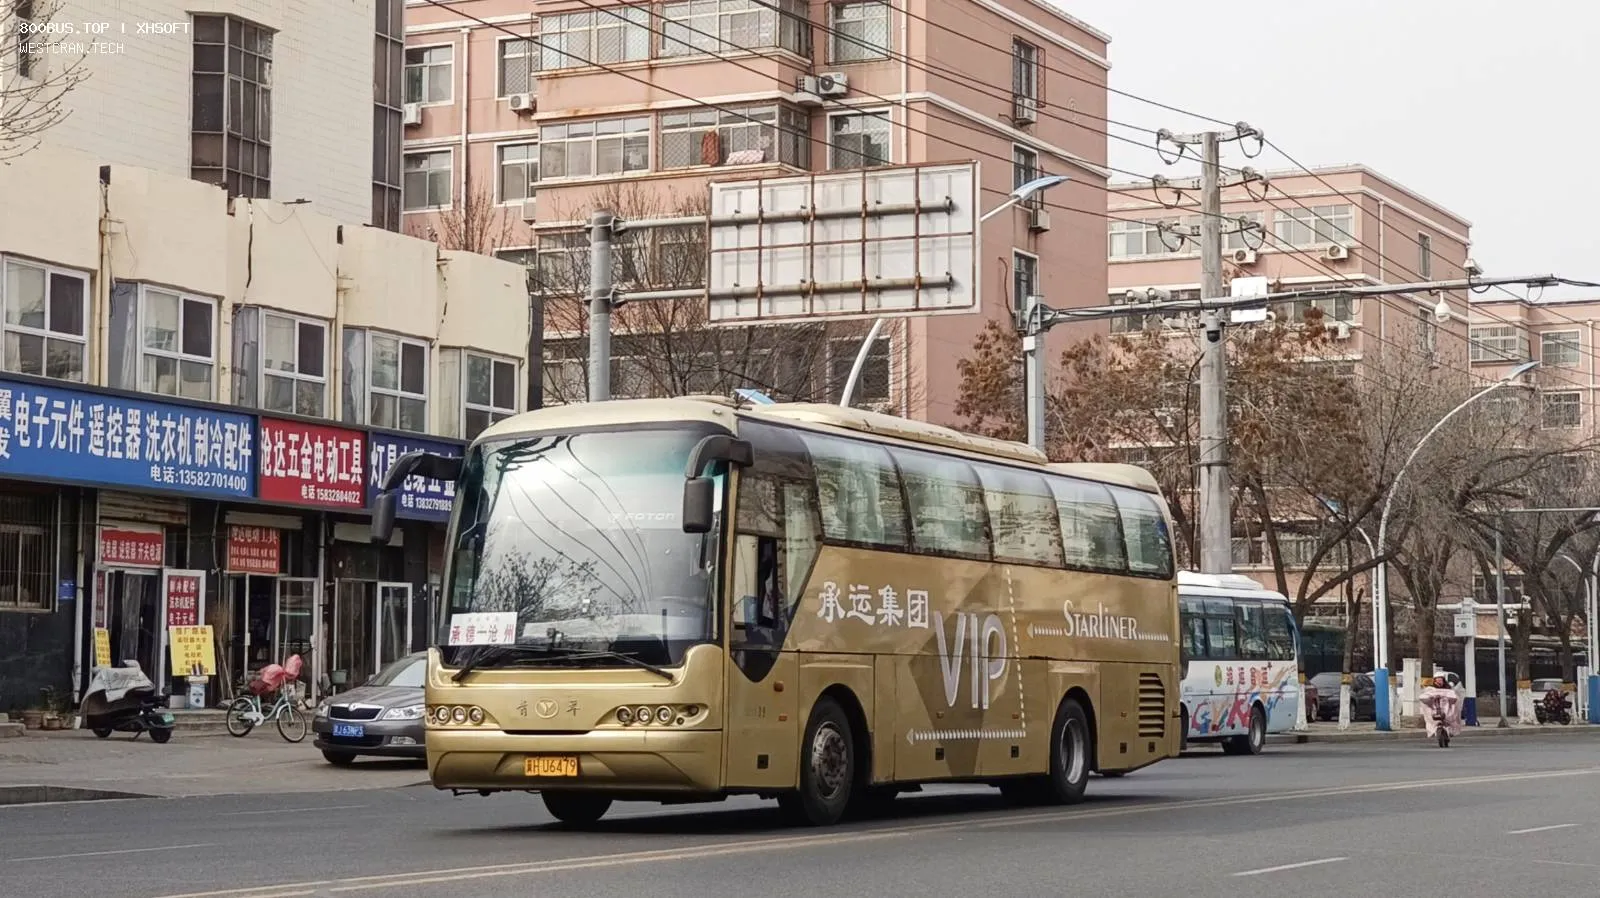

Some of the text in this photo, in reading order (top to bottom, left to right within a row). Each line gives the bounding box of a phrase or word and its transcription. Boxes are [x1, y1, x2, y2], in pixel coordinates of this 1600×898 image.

[14, 392, 251, 474] 电子元件 遥控器 洗衣机 制冷配件
[816, 581, 930, 630] 承运集团
[934, 610, 1008, 710] VIP
